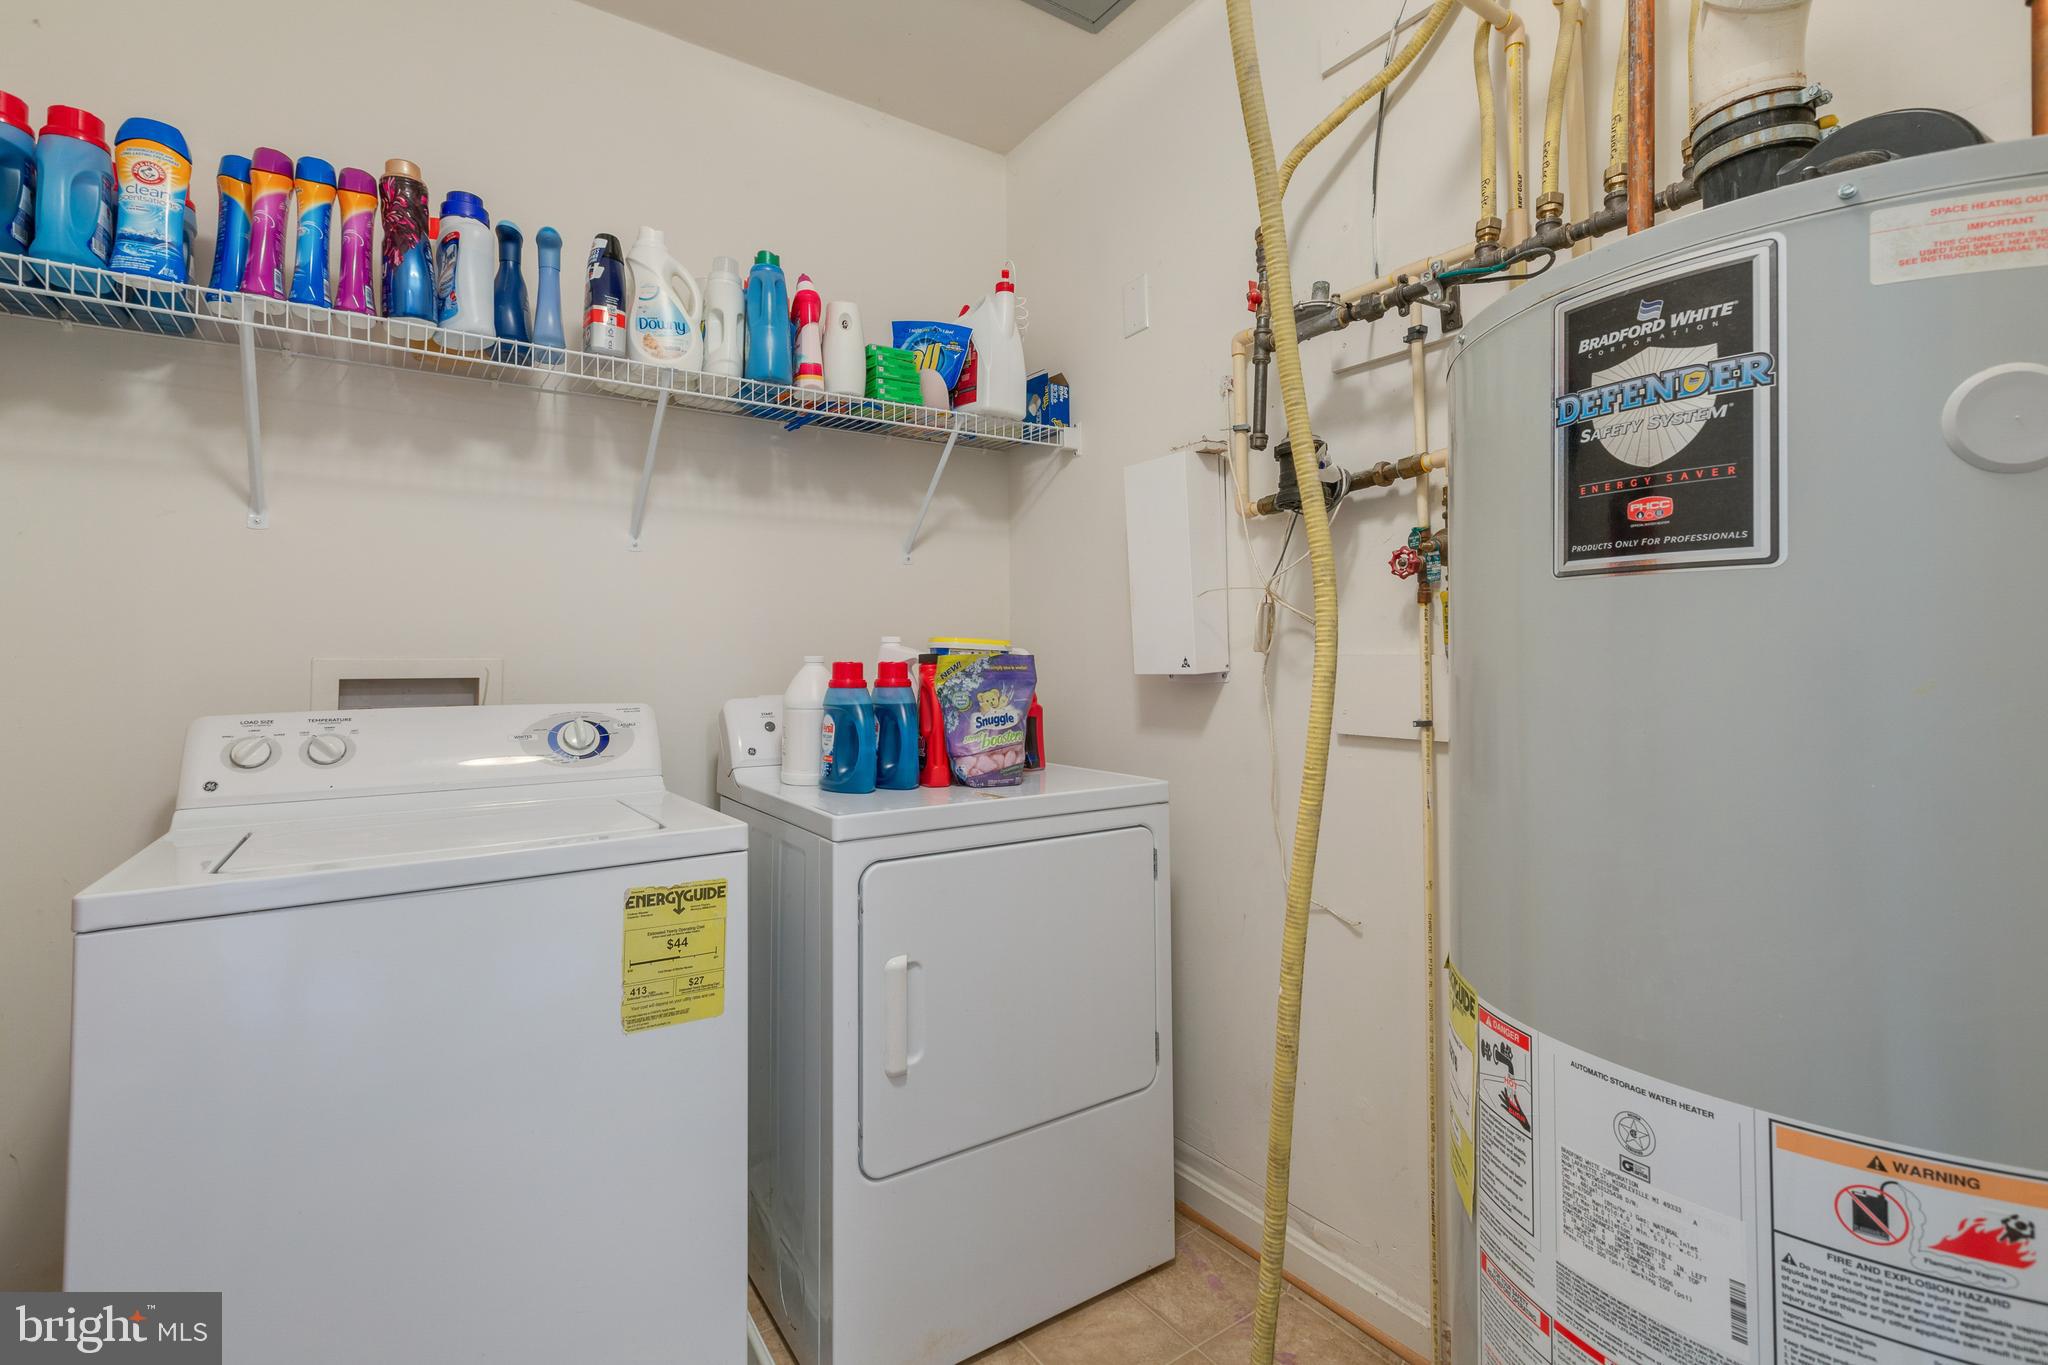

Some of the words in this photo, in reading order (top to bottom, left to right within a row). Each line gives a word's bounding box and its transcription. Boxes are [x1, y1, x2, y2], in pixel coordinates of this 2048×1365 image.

[125, 184, 173, 198] clean
[1481, 178, 1490, 208] Range
[1930, 204, 1969, 216] SPACE
[1971, 197, 2022, 210] HEATING
[1967, 216, 2035, 231] IMPORTANT
[1920, 247, 1947, 257] USED
[1973, 240, 2004, 249] SPACE
[1934, 239, 1956, 247] THIS
[1958, 231, 2025, 244] CONNECTION
[1898, 258, 1918, 267] SEE
[1920, 249, 1987, 264] INSTRUCTION
[1991, 244, 2032, 255] MANUAL
[1578, 318, 1665, 354] BRADFORD
[1670, 301, 1736, 329] WHITE
[1587, 320, 1719, 359] CORPORATION
[1556, 353, 1775, 426] DEFENDER
[1580, 419, 1644, 443] SAFETY
[1580, 476, 1652, 496] ENERGY
[1666, 466, 1736, 482] SAVER
[1629, 500, 1671, 512] PHCC
[1571, 543, 1613, 553] PRODUCTS
[1615, 539, 1639, 548] ONLY
[1641, 537, 1661, 545] FOR
[1663, 531, 1749, 544] PROFESSIONALS
[975, 713, 1014, 729] Snuggle
[626, 885, 726, 909] ENERGYGUIDE
[667, 937, 688, 950] $44
[630, 986, 647, 996] 413
[689, 976, 704, 986] $27
[1494, 1021, 1520, 1042] DANGER
[1504, 1076, 1517, 1088] HOT
[1570, 1061, 1609, 1082] AUTOMATIC
[1610, 1077, 1647, 1097] STORAGE
[1648, 1090, 1678, 1107] WATER
[1678, 1102, 1715, 1120] HEATER
[1561, 1146, 1582, 1162] BRADFORD
[1585, 1158, 1599, 1170] WHITE
[1602, 1167, 1638, 1188] CORPORATION
[1892, 1160, 1981, 1190] WARNING
[1571, 1158, 1598, 1176] LAFAYETTE
[1612, 1178, 1648, 1199] MIDDLEVILLE
[1663, 1200, 1681, 1213] 49333
[1652, 1221, 1678, 1237] NATURAL
[1617, 1229, 1630, 1240] FROM
[1633, 1238, 1671, 1260] COMBUSTIBLE
[1679, 1239, 1698, 1252] Inlet
[1688, 1276, 1700, 1285] TOP
[1691, 1270, 1706, 1282] LEFT
[1827, 1253, 1853, 1267] FIRE
[1856, 1263, 1880, 1275] AND
[1884, 1270, 1954, 1296] EXPLOSION
[1958, 1292, 2011, 1309] HAZARD
[1843, 1268, 1858, 1277] Can
[1860, 1274, 1882, 1285] result
[1894, 1285, 1925, 1296] serious
[1927, 1293, 1950, 1304] injury
[1974, 1270, 2007, 1282] Vapors
[1781, 1265, 1809, 1279] liquids
[1821, 1279, 1834, 1288] the
[1837, 1285, 1868, 1299] vicinity
[1882, 1298, 1899, 1308] this
[1914, 1309, 1930, 1318] any
[1933, 1314, 1956, 1323] other
[1782, 1291, 1805, 1306] injury
[1799, 1262, 1811, 1271] Do
[1813, 1268, 1827, 1276] not
[1829, 1273, 1851, 1284] store
[1865, 1285, 1880, 1293] use
[1883, 1290, 1922, 1304] gasoline
[1937, 1306, 1961, 1315] other
[1964, 1311, 2013, 1328] flammable
[1781, 1283, 1794, 1292] the
[1797, 1289, 1826, 1304] vicinity
[1840, 1303, 1856, 1313] this
[1870, 1314, 1886, 1324] any
[1889, 1319, 1912, 1330] other
[1915, 1327, 1960, 1344] appliance
[1963, 1341, 1979, 1349] can
[1982, 1346, 2010, 1357] result
[1802, 1282, 1818, 1291] use
[1830, 1292, 1867, 1307] gasoline
[1882, 1308, 1905, 1319] other
[1908, 1315, 1955, 1333] flammable
[1958, 1331, 1990, 1342] vapors
[2007, 1342, 2039, 1354] liquids
